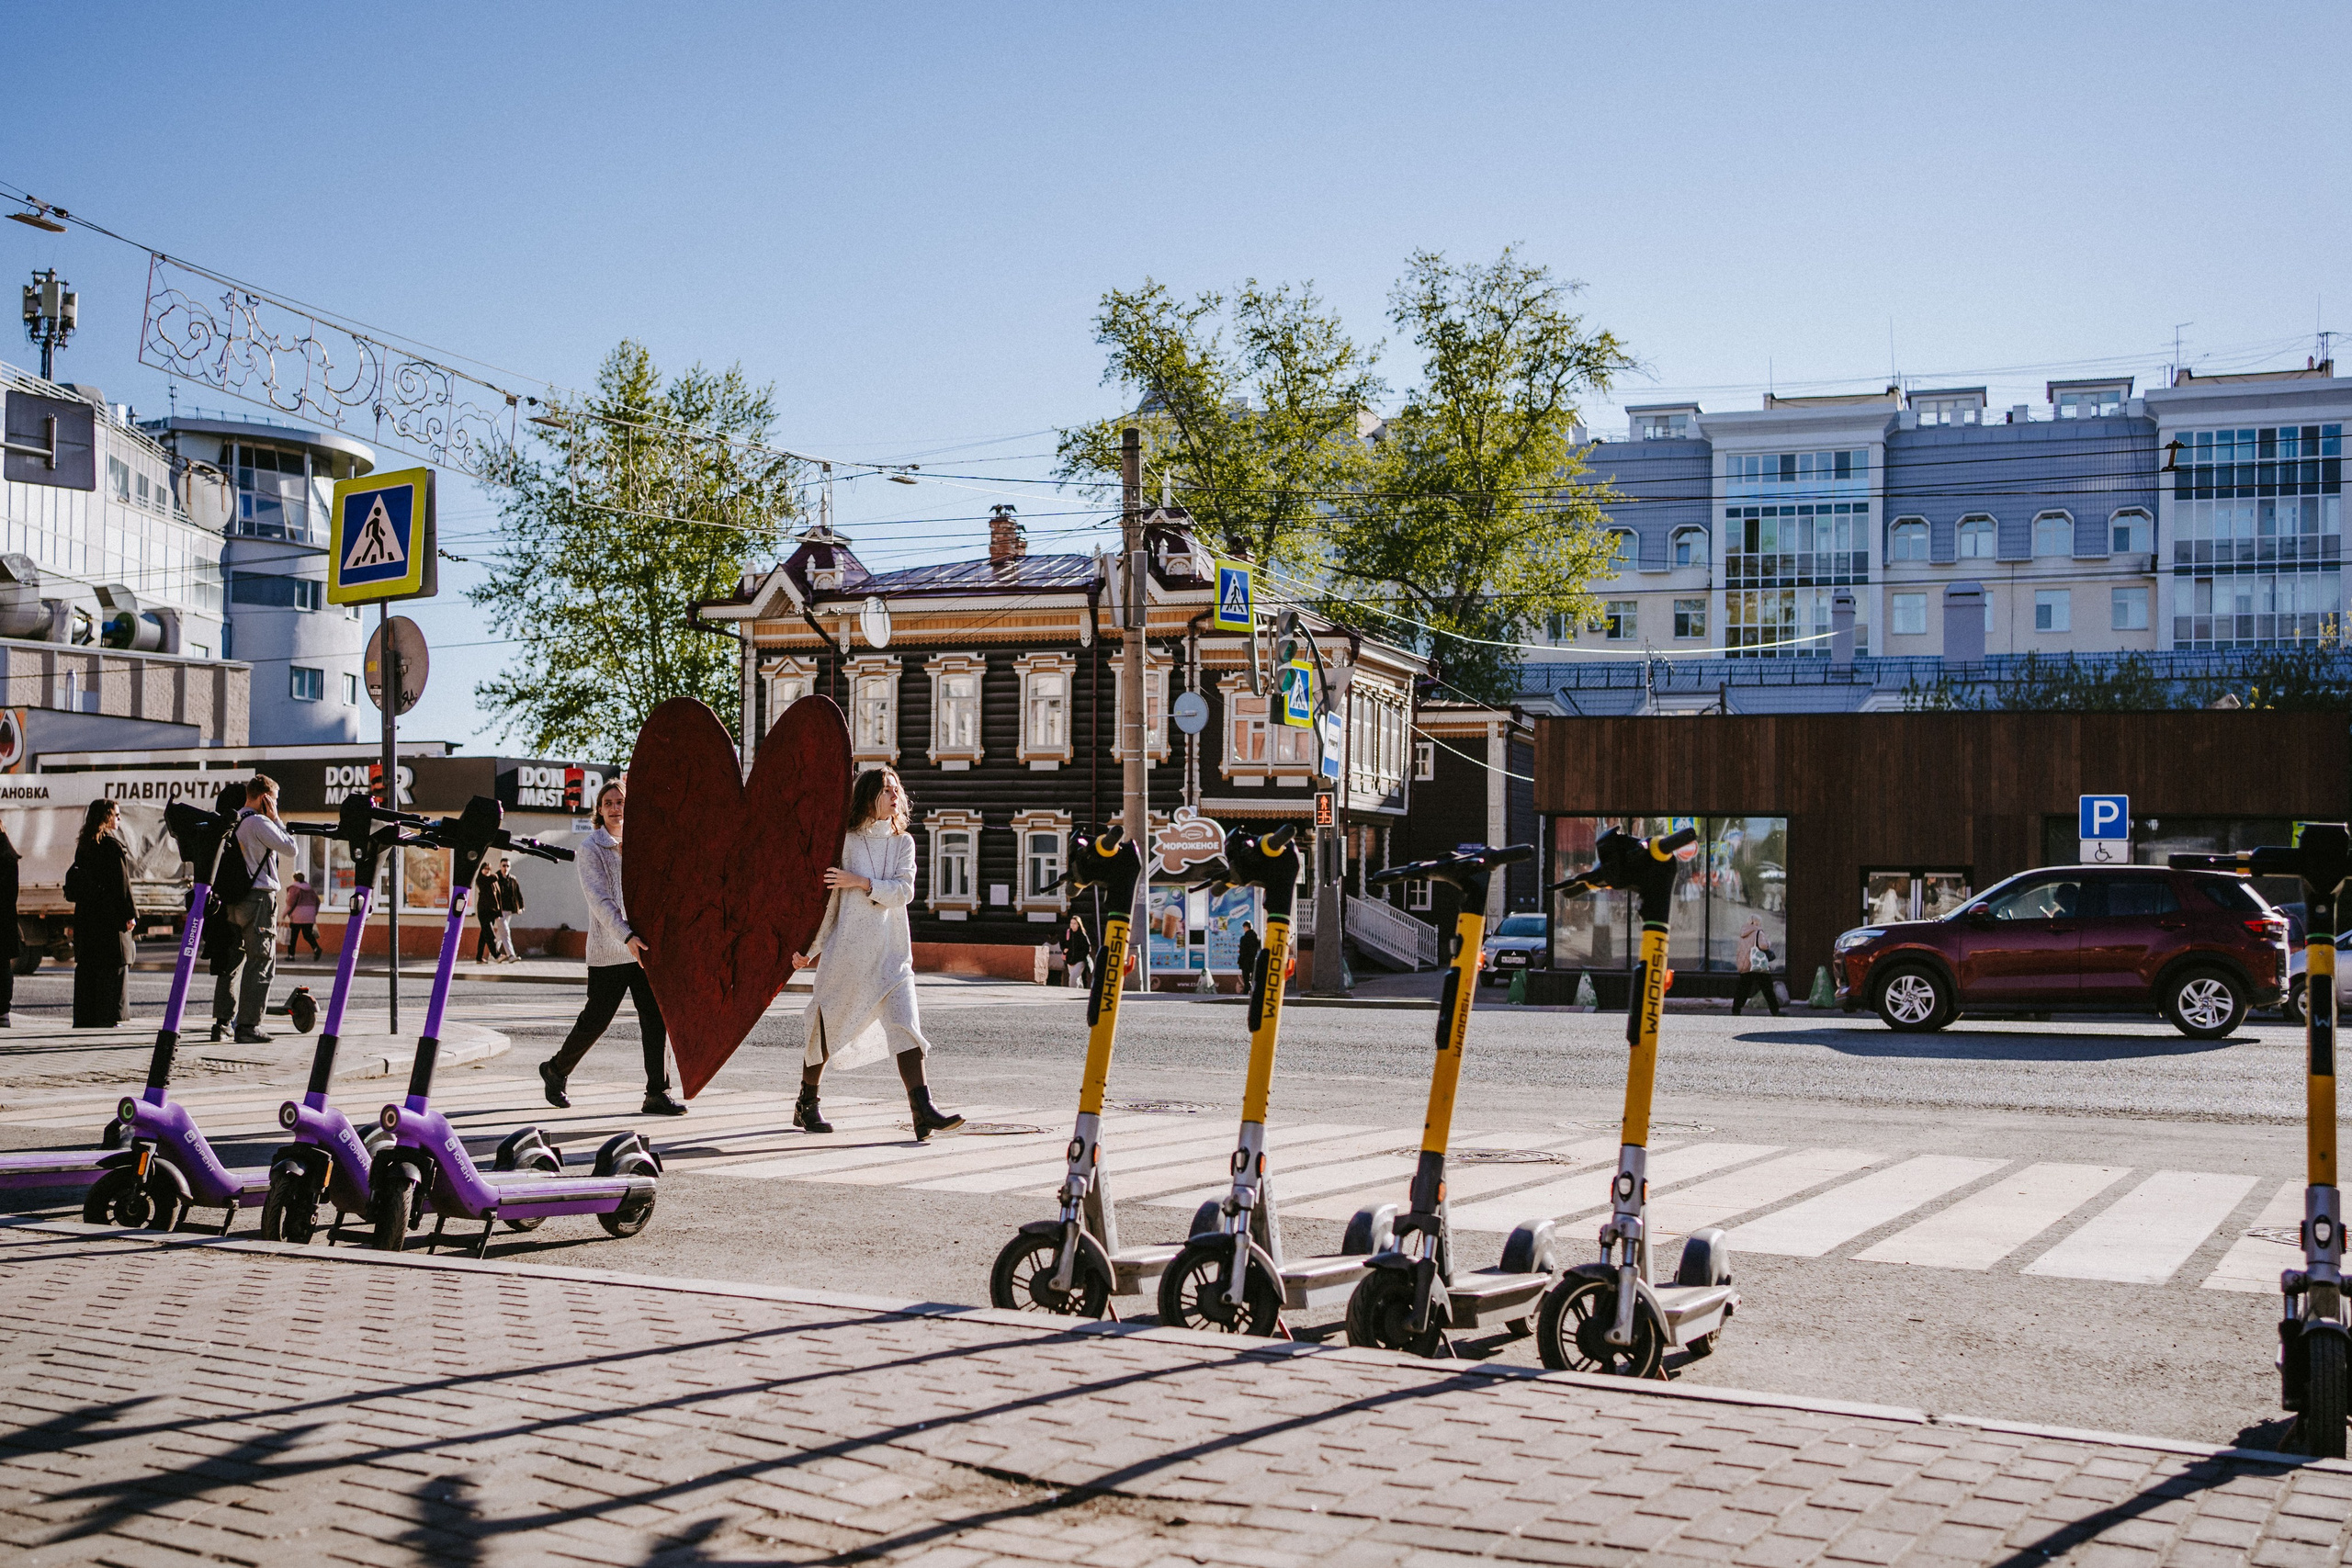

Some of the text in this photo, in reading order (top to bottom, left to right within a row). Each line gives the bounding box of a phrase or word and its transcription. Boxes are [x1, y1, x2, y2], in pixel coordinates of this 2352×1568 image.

[0, 787, 50, 799] АНОВКА
[104, 781, 249, 799] ГЛАВПОЧТА
[1317, 810, 1331, 824] 35
[2093, 799, 2120, 836] P
[1162, 840, 1219, 851] МОРОЖЕНОЕ
[187, 917, 199, 946] ЮРЕНТ
[1101, 925, 1125, 1013] WHOOSH
[1263, 928, 1285, 1019] WHOOSH
[1645, 936, 1665, 1034] WHOOSH
[1453, 991, 1471, 1058] WHOOSH
[193, 1141, 216, 1172] ЮРЕНТ
[347, 1141, 371, 1171] ЮРЕНТ
[452, 1150, 474, 1183] ЮРЕНТ
